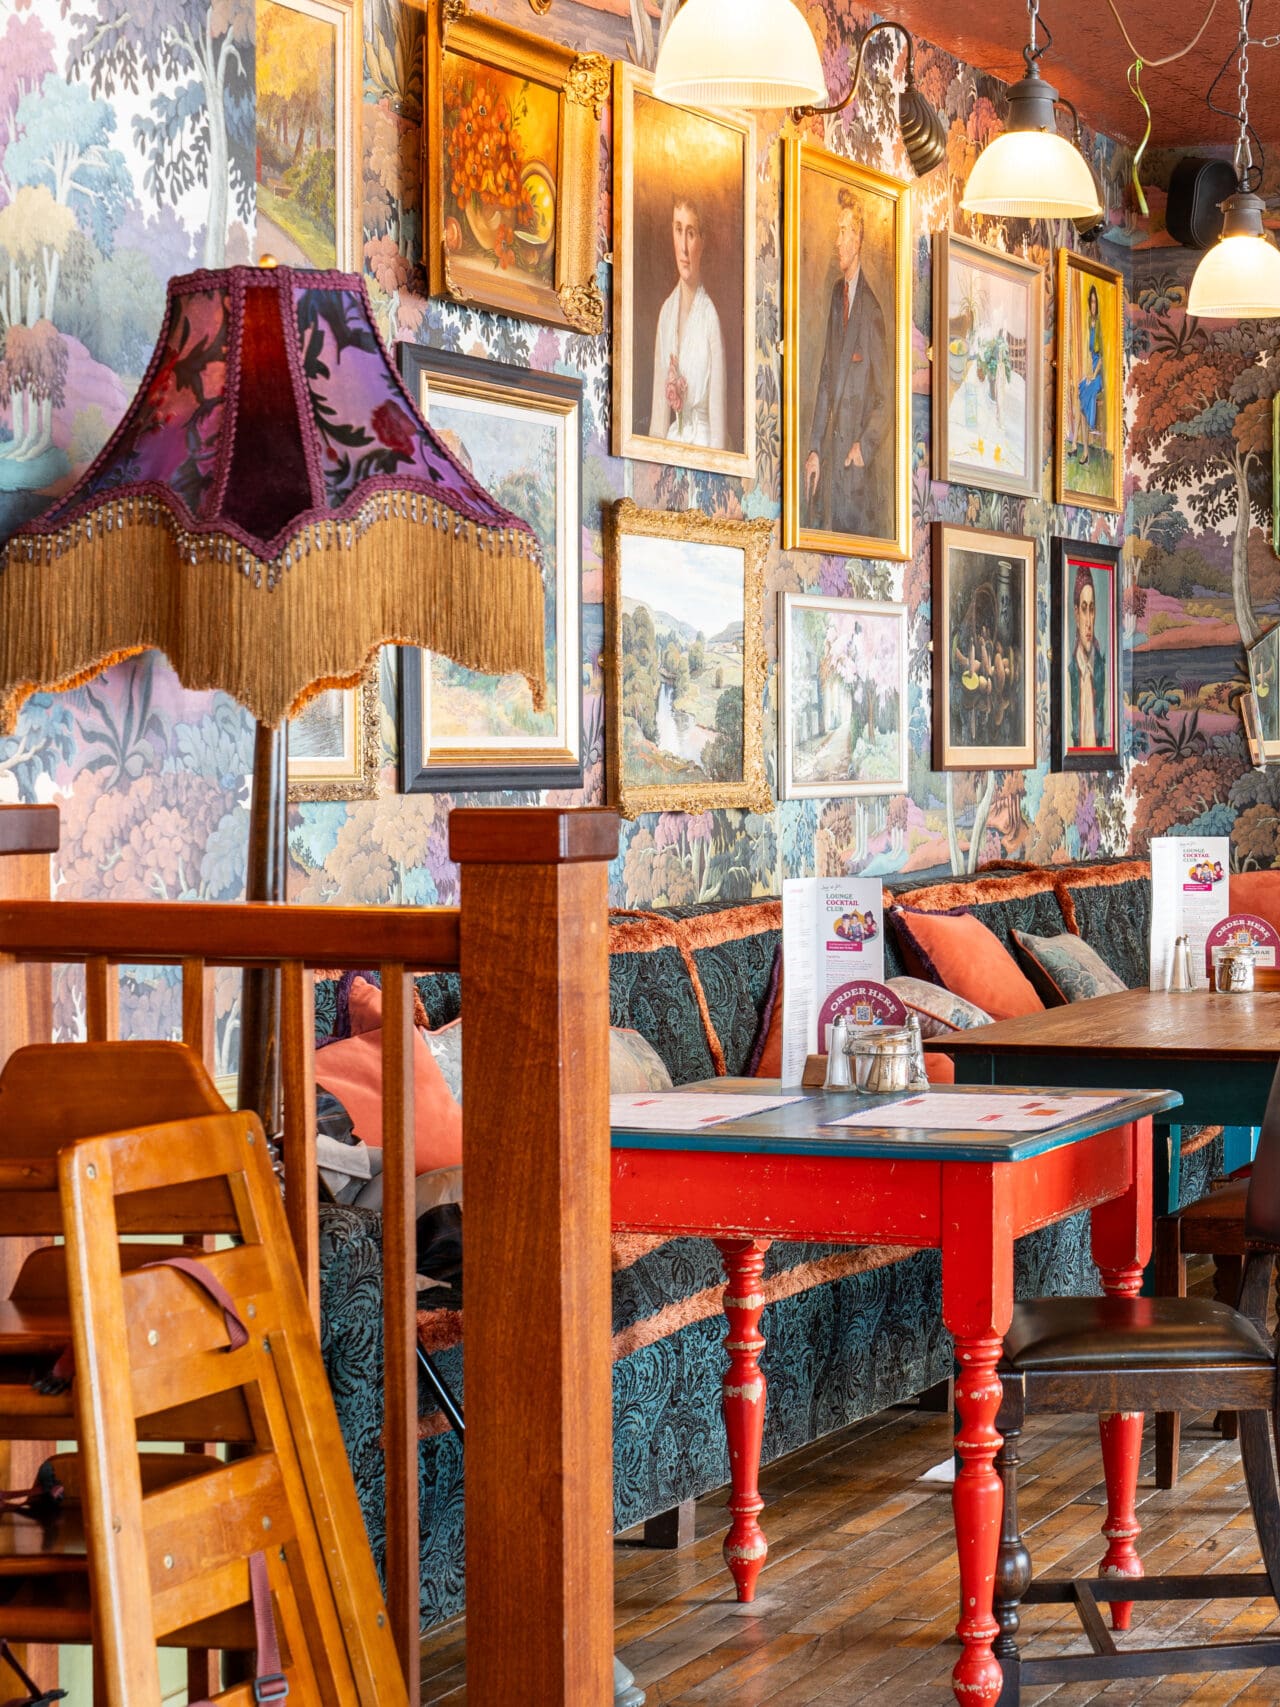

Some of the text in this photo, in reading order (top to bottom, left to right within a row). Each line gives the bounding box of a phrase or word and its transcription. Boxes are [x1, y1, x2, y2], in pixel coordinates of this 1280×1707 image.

[1216, 919, 1271, 938] ORDER HERE
[830, 987, 898, 1014] ORDER HERE
